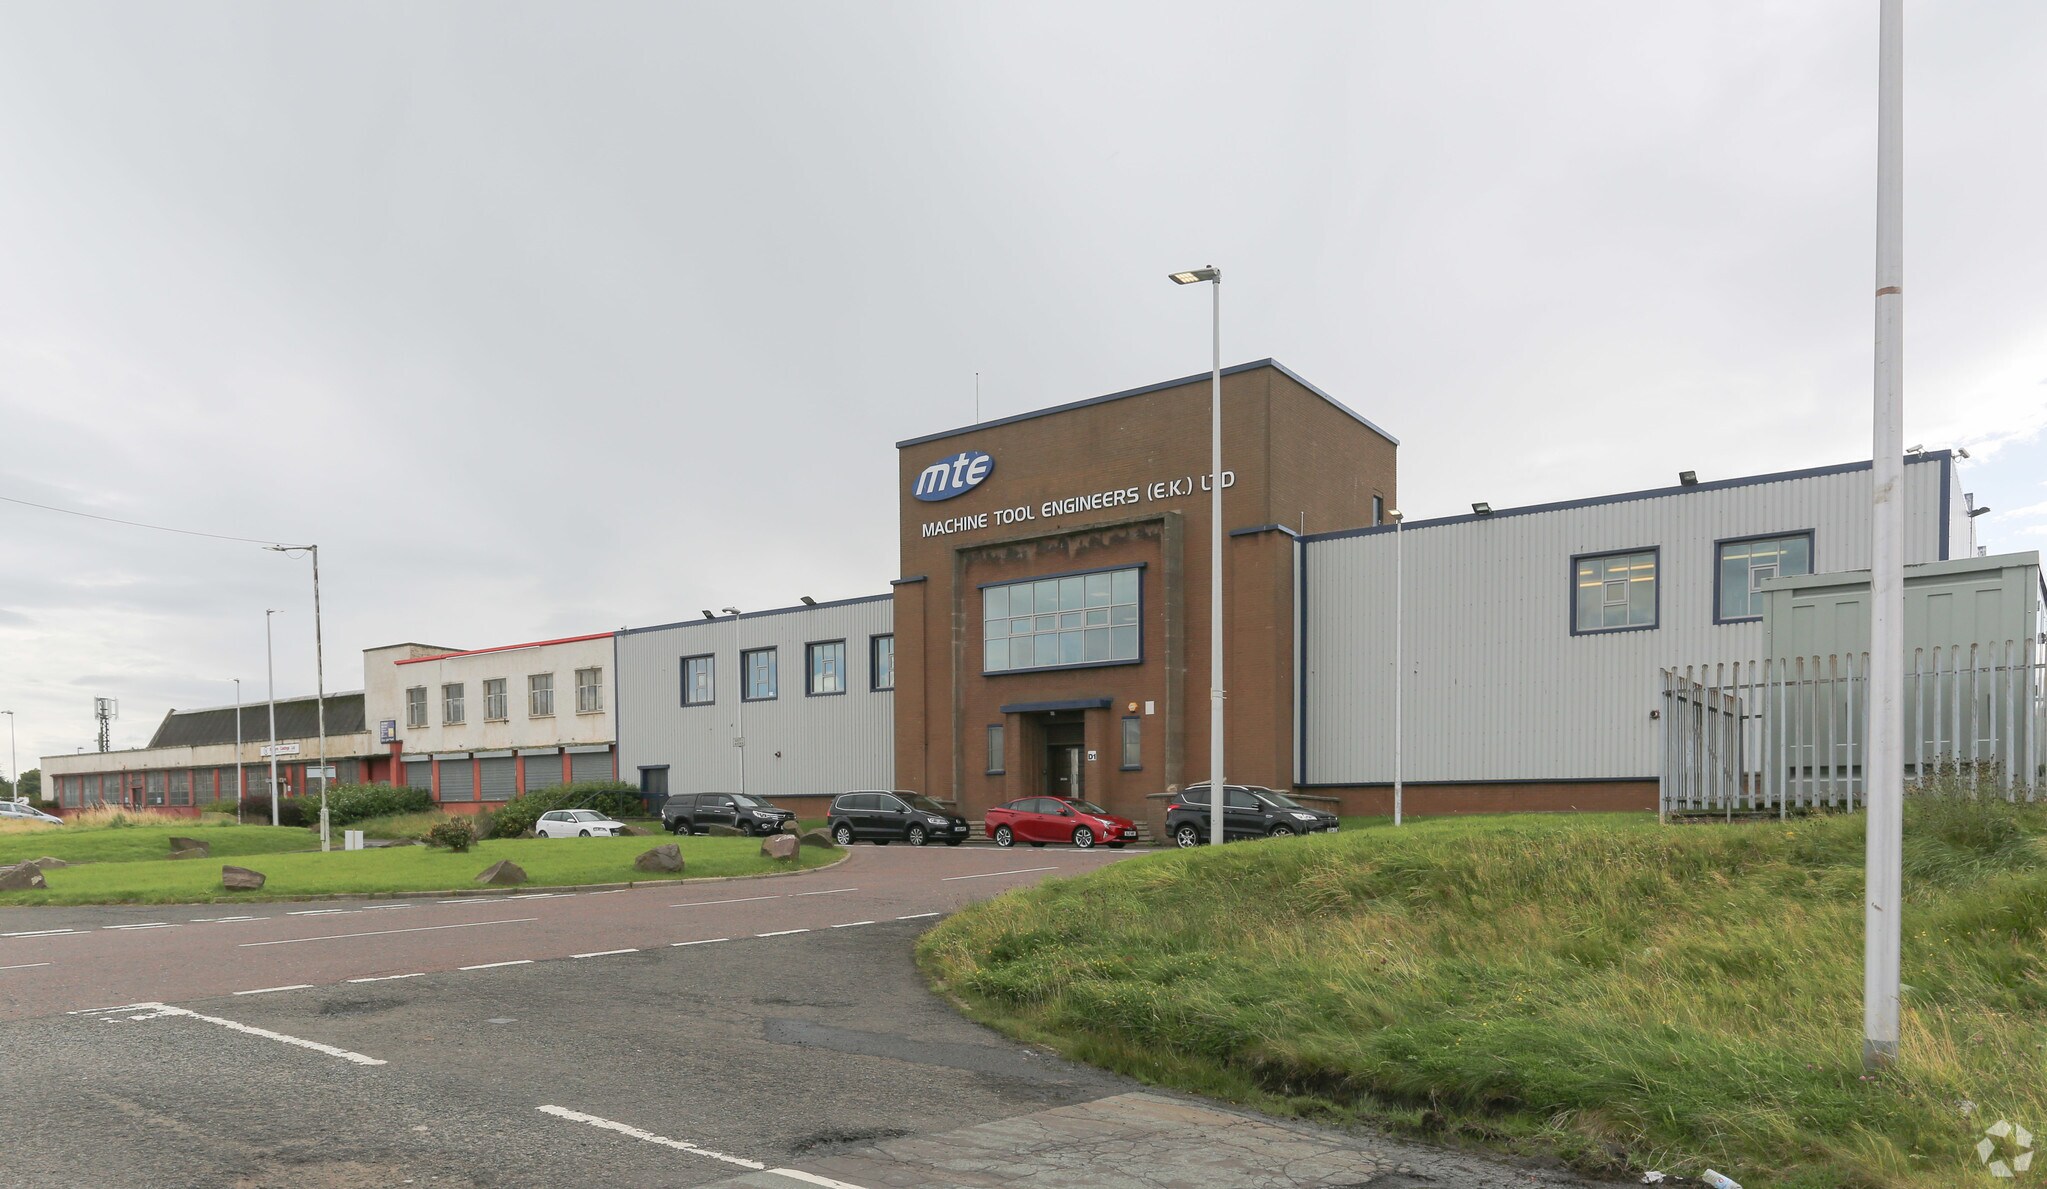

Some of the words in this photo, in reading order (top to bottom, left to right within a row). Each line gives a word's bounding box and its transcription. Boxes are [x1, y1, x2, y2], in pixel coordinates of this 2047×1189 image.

[915, 452, 990, 496] mte
[922, 513, 988, 538] MACHINE
[993, 505, 1036, 526] TOOL
[1041, 486, 1140, 518] ENGINEERS
[1147, 476, 1193, 501] (E.K.)
[1201, 470, 1236, 491] LD
